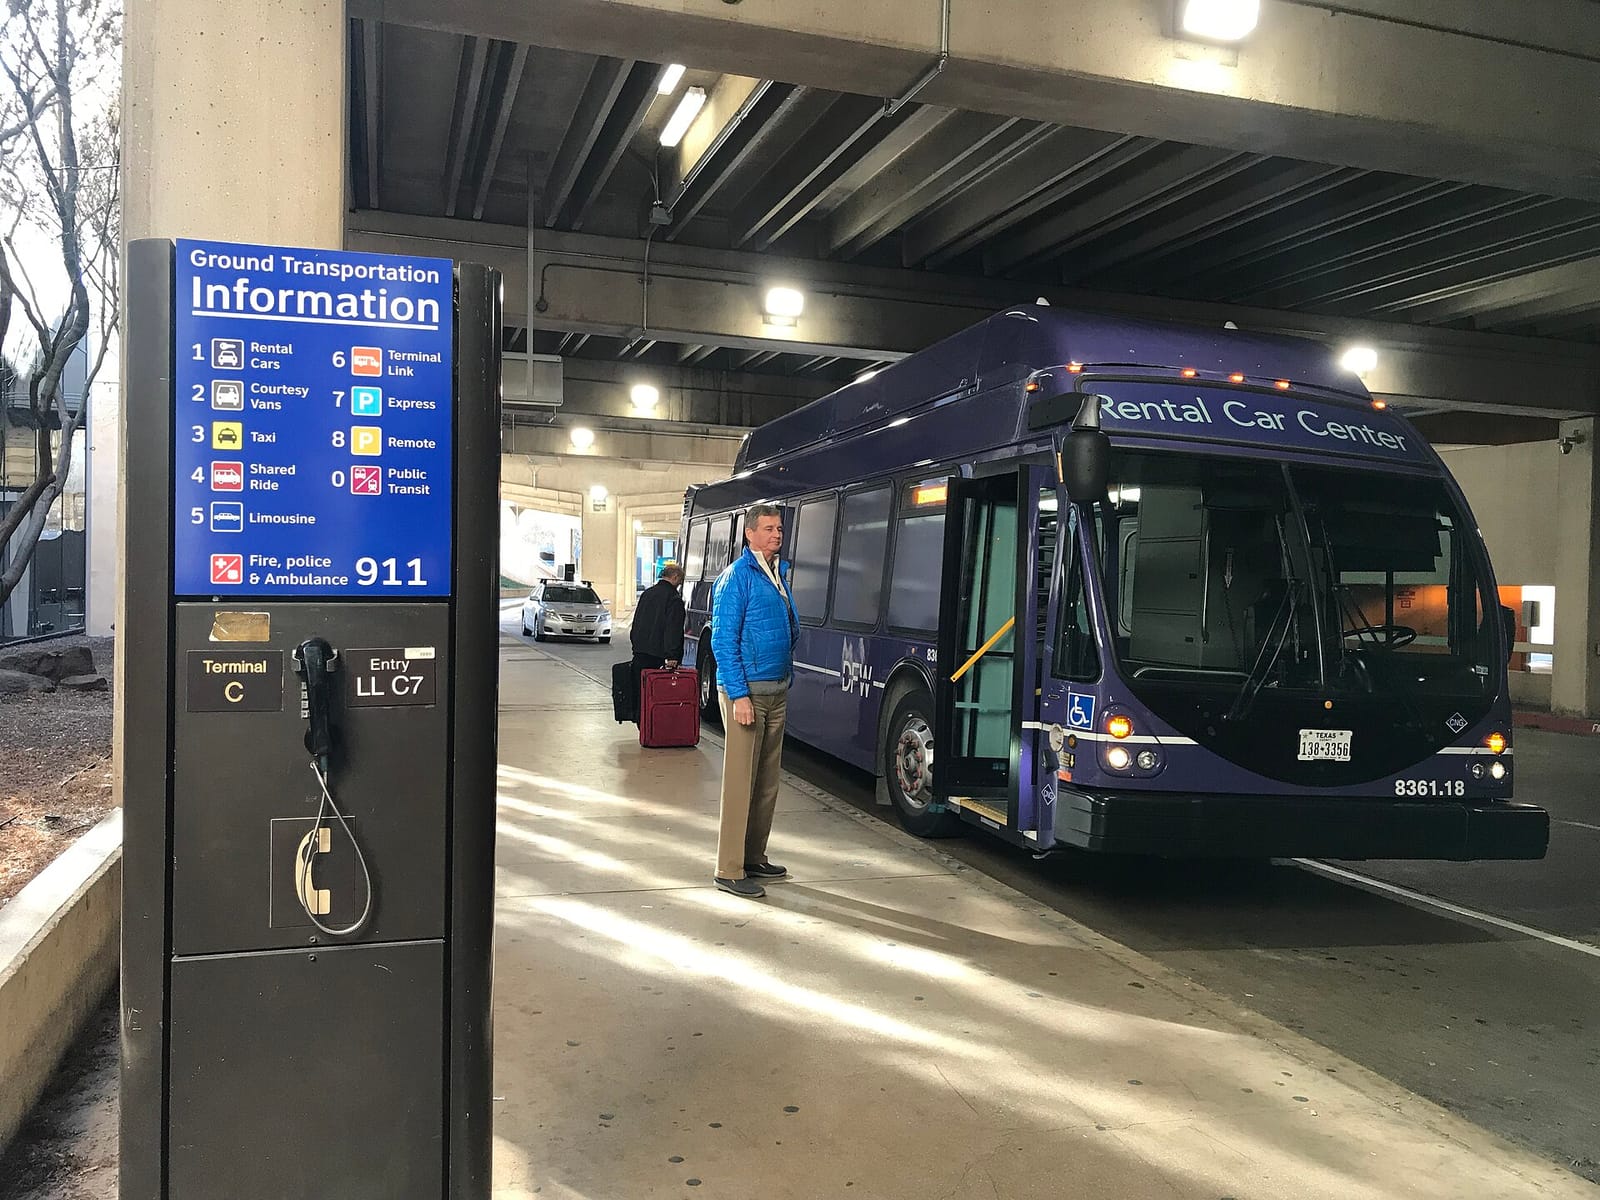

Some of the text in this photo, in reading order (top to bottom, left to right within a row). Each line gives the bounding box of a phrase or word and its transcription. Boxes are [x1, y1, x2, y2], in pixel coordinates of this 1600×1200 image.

[190, 249, 439, 284] Ground Transportation
[192, 276, 439, 323] Information
[192, 344, 205, 361] 1
[250, 342, 293, 355] Rental
[388, 350, 442, 363] Terminal
[250, 358, 281, 370] Cars
[332, 351, 345, 368] 6
[388, 365, 414, 377] Link
[191, 384, 205, 402] 2
[250, 383, 309, 398] Courtesy
[250, 399, 282, 411] Vans
[332, 391, 345, 408] 7
[388, 397, 436, 411] Express
[1098, 394, 1407, 451] Rental Car Center
[191, 425, 276, 443] 3 Taxi
[332, 431, 345, 448] 8
[388, 437, 436, 449] Remote
[191, 466, 205, 484] 4
[250, 463, 296, 476] Shared
[388, 468, 427, 480] Public
[250, 479, 279, 491] Ride
[332, 470, 345, 488] 0
[388, 484, 430, 496] Transit
[191, 507, 316, 525] 5 Limousine
[249, 555, 332, 570] Fire, police
[249, 573, 349, 586] & Ambulance
[355, 557, 428, 586] 911
[203, 660, 267, 673] Terminal
[371, 658, 410, 672] Entry
[356, 675, 424, 697] LL C7
[842, 660, 873, 698] DFW
[224, 681, 244, 703] C
[1449, 719, 1464, 727] CNG
[1395, 780, 1465, 796] 8361.18
